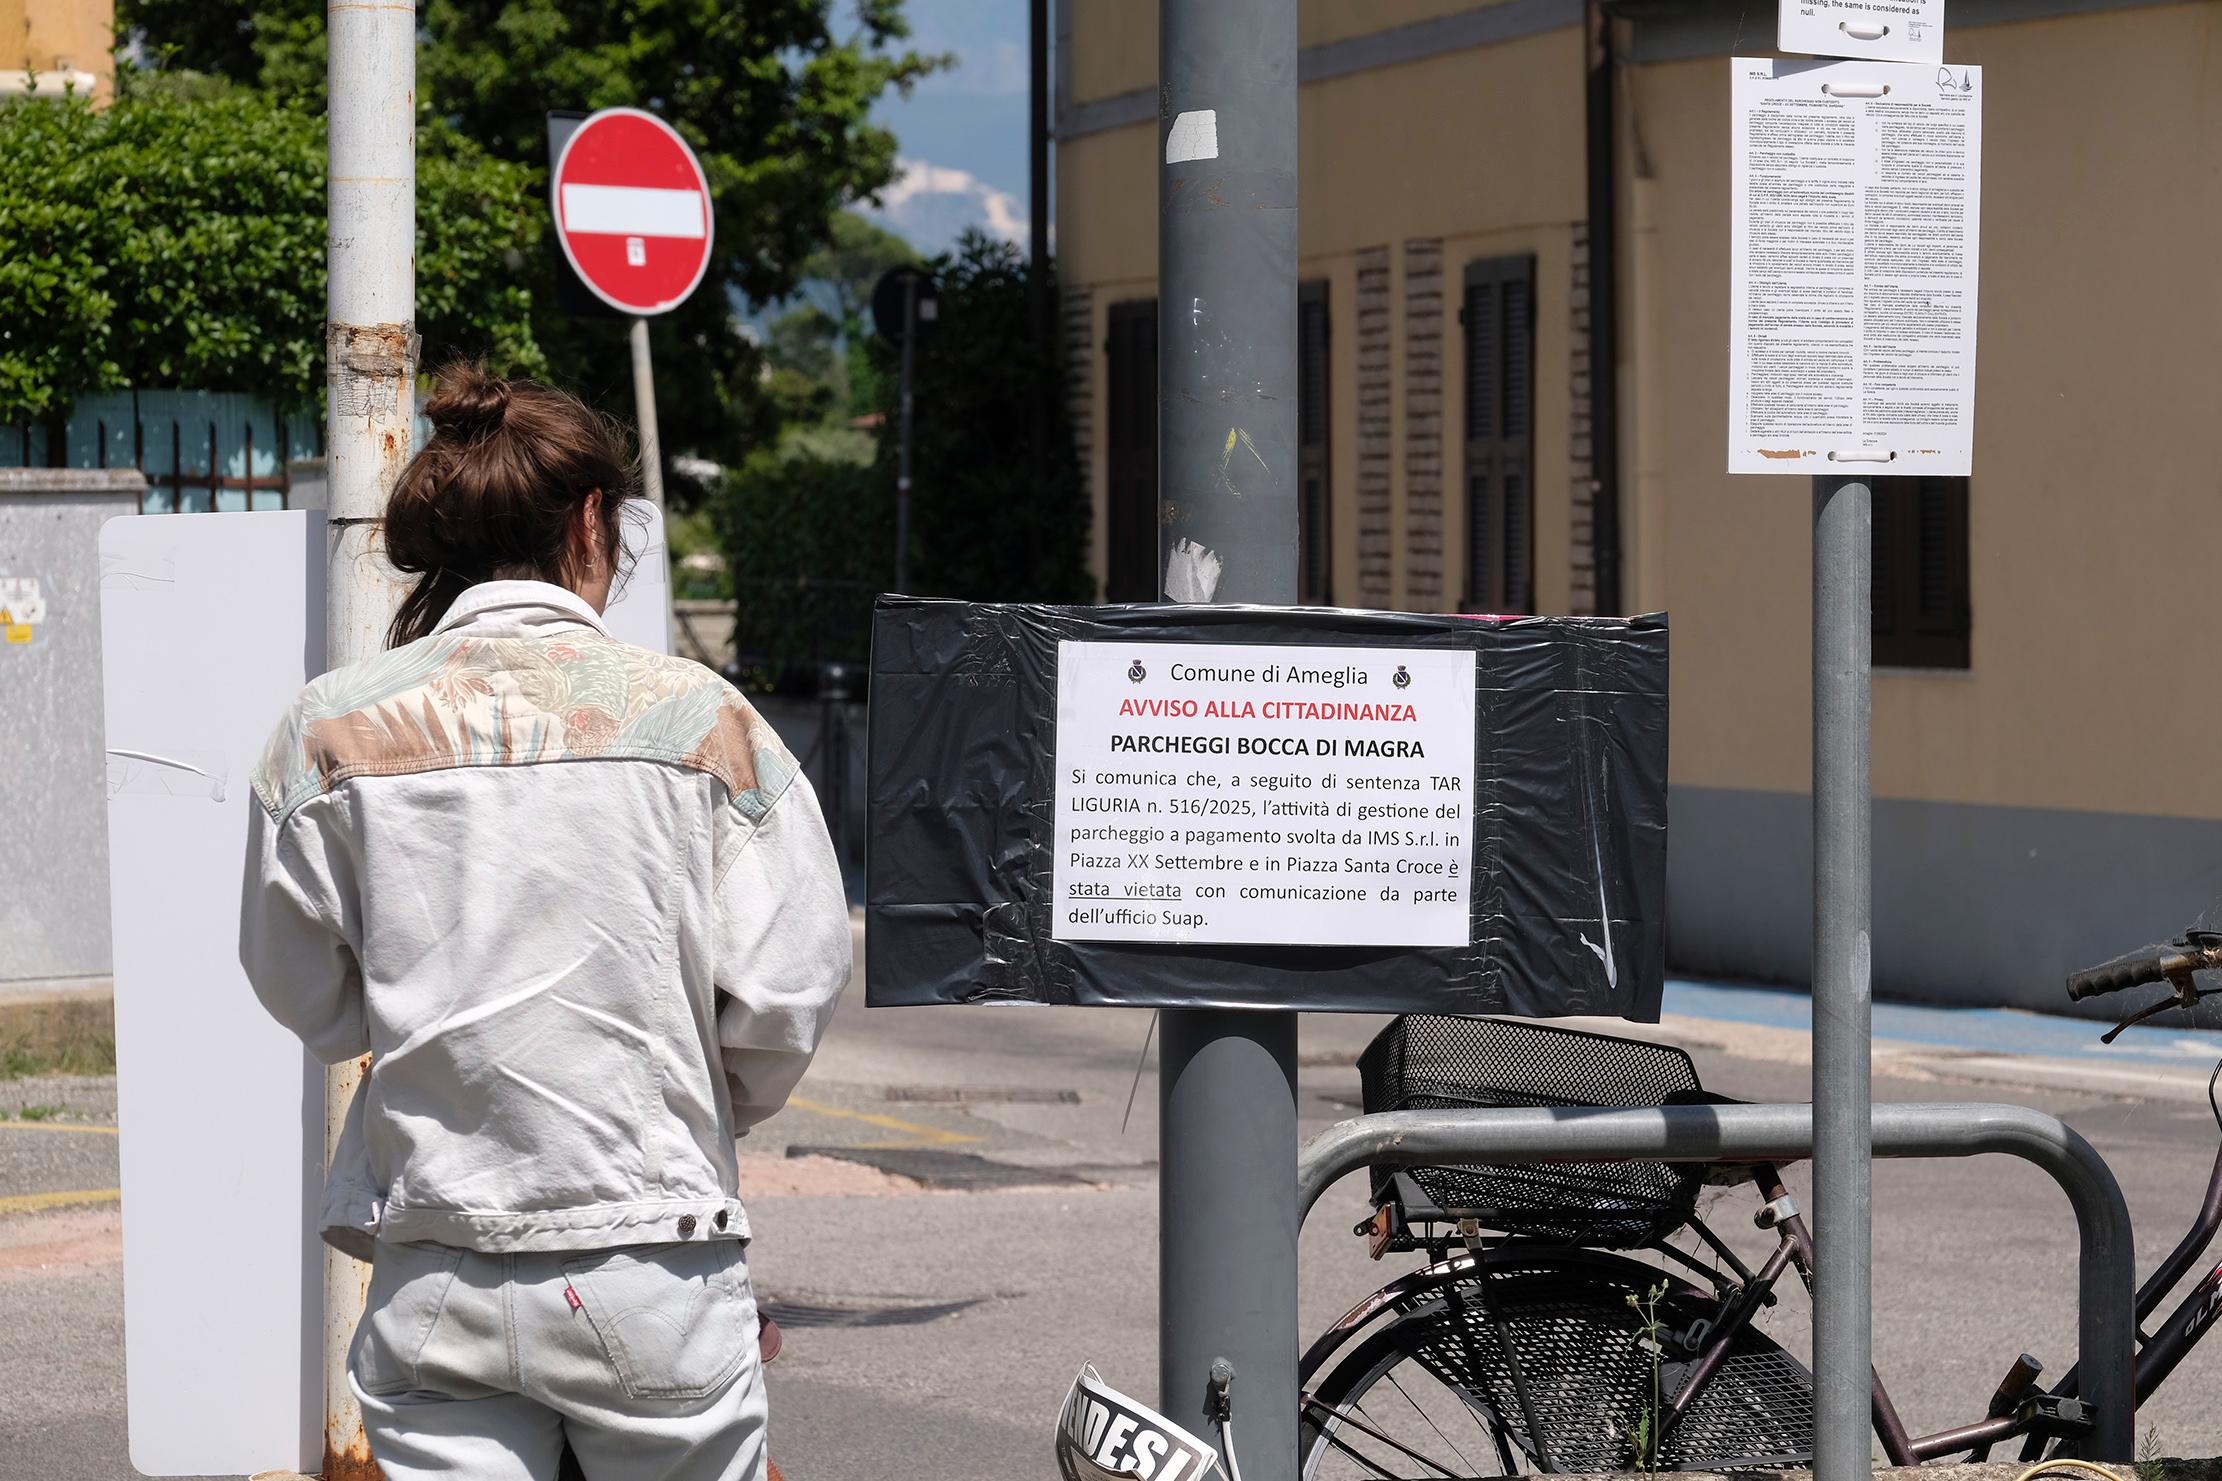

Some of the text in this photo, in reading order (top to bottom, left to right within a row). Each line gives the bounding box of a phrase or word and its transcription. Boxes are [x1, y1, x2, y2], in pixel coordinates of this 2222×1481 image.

[1832, 0, 1843, 8] the
[1865, 3, 1871, 11] is
[1873, 5, 1910, 14] considered
[1170, 663, 1368, 689] Comune di Ameglia
[1119, 698, 1417, 722] AVVISO ALLA CITTADINANZA
[1111, 734, 1425, 759] PARCHEGGI BOCCA DI MAGRA
[1071, 768, 1461, 792] Si comunica che, a seguito di sentenza TAR
[1072, 797, 1460, 821] LIGURIA n. 516/2025, l’attività di gestione del
[1071, 824, 1459, 847] parcheggio a pagamento svolta da IMS S.r.l. in
[1070, 852, 1459, 879] Piazza XX Settembre e in Piazza Santa Croce è
[1068, 881, 1458, 905] stata vietata con comunicazione da parte
[1068, 907, 1208, 929] dell’ufficio Suap.
